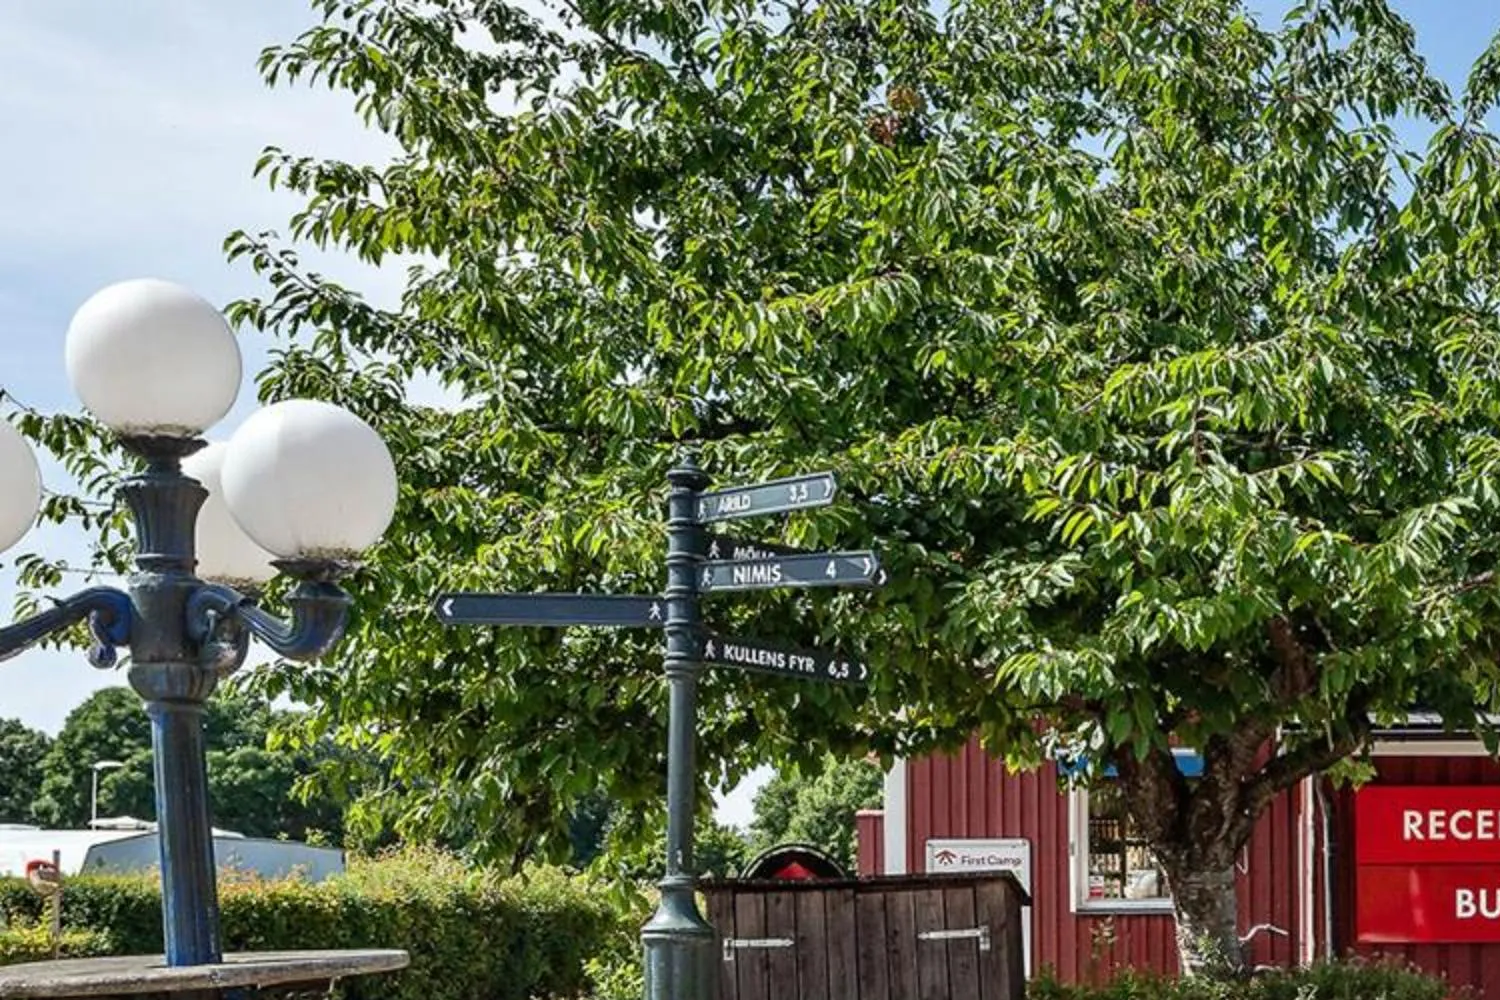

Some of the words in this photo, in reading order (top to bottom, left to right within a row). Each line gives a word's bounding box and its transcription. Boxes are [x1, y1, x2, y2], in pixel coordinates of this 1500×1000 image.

[733, 563, 781, 584] NIMIS
[826, 560, 837, 579] 4
[723, 643, 785, 669] KULLENS
[789, 654, 815, 673] FYR
[828, 660, 849, 679] 6,5
[961, 855, 985, 865] First
[987, 854, 1022, 867] Camp
